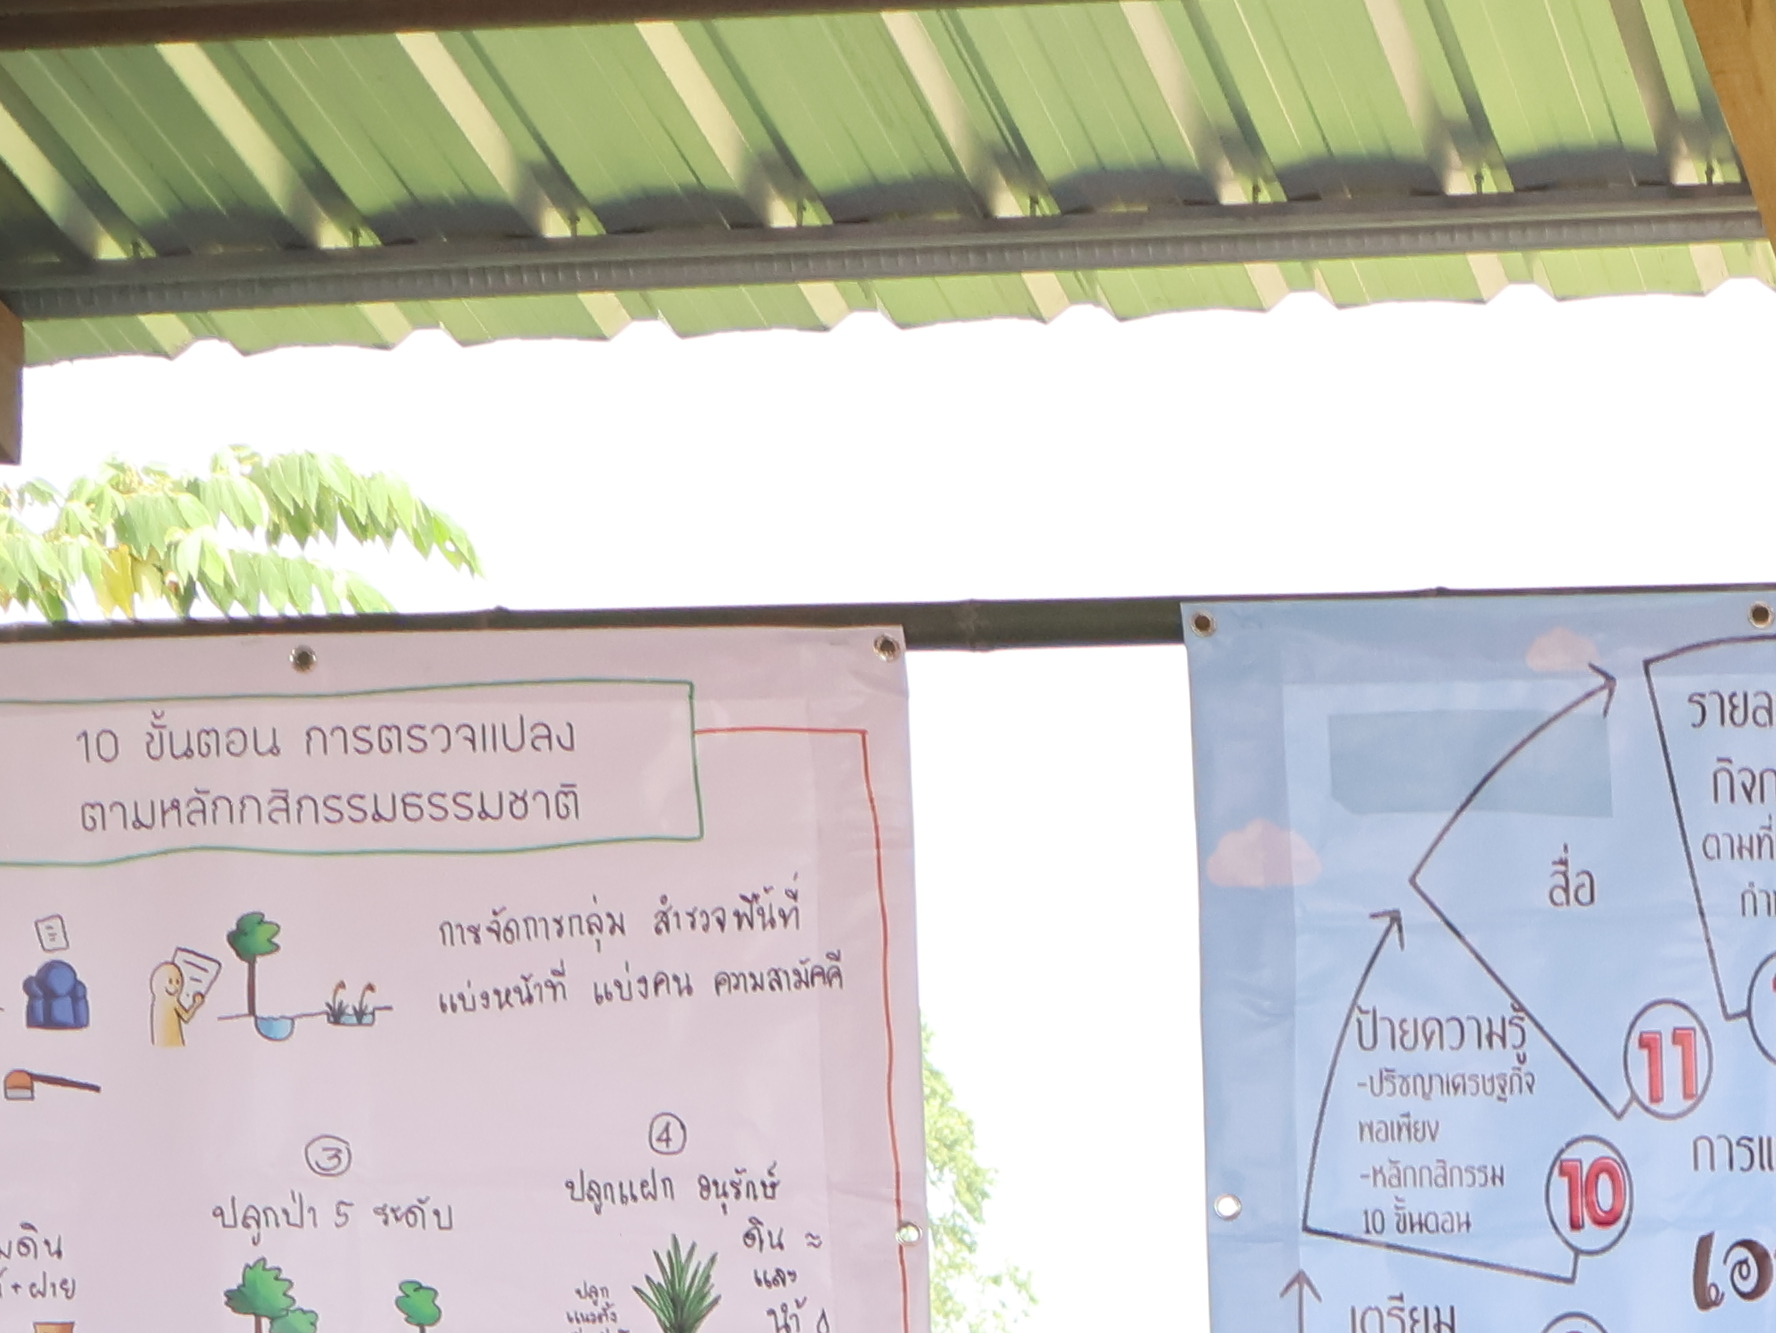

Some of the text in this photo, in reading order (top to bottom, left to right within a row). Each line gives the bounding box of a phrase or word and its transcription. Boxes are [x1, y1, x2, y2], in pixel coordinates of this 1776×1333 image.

[76, 711, 577, 764] 10 ขั้นตอน การตรวจแปลง
[80, 781, 581, 833] ตามหลักกสิกรรมธรรมชาติ
[1548, 842, 1597, 907] สื่อ
[438, 894, 626, 953] การจัดการกลุ่ม
[438, 949, 844, 1014] แบ่งหน้าที่ แบ่งคน ความสามัคคี
[1355, 1001, 1528, 1066] ป้ายความรู้
[1637, 1027, 1699, 1105] 11
[1358, 1111, 1440, 1144] พอเพียง
[564, 1160, 781, 1216] ปลูกแฝก อนุรักษ์
[1363, 1196, 1473, 1236] 10 ขั้นตอน
[1558, 1156, 1628, 1233] 10
[212, 1190, 319, 1247] ปลูกป่า
[334, 1201, 354, 1229] 5
[742, 1216, 784, 1252] ดิน
[575, 1280, 610, 1307] ปลูก
[753, 1266, 798, 1289] และ
